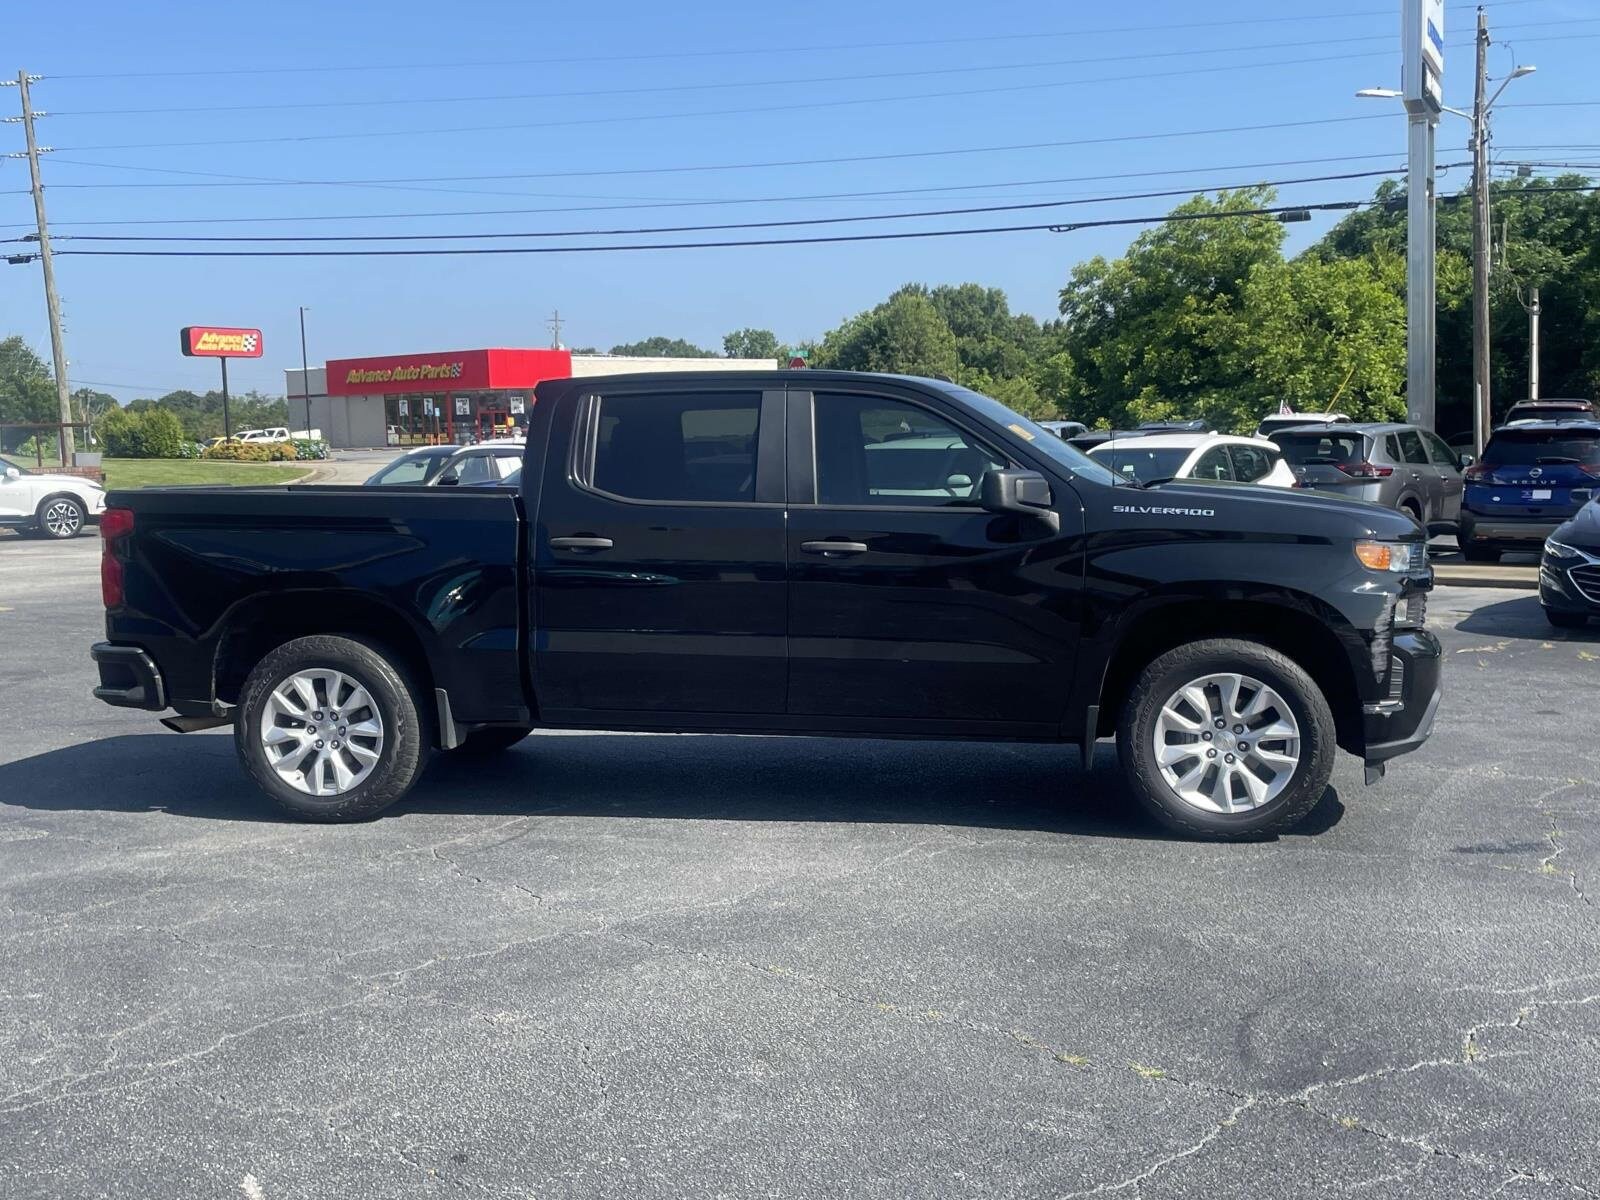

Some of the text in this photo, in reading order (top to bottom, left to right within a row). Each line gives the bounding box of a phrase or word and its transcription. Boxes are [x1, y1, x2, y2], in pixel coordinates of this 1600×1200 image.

[201, 332, 242, 343] Advance
[195, 342, 243, 352] Auto Parts
[346, 363, 450, 384] Advance Auto Parts
[1112, 505, 1215, 517] SILVERADO
